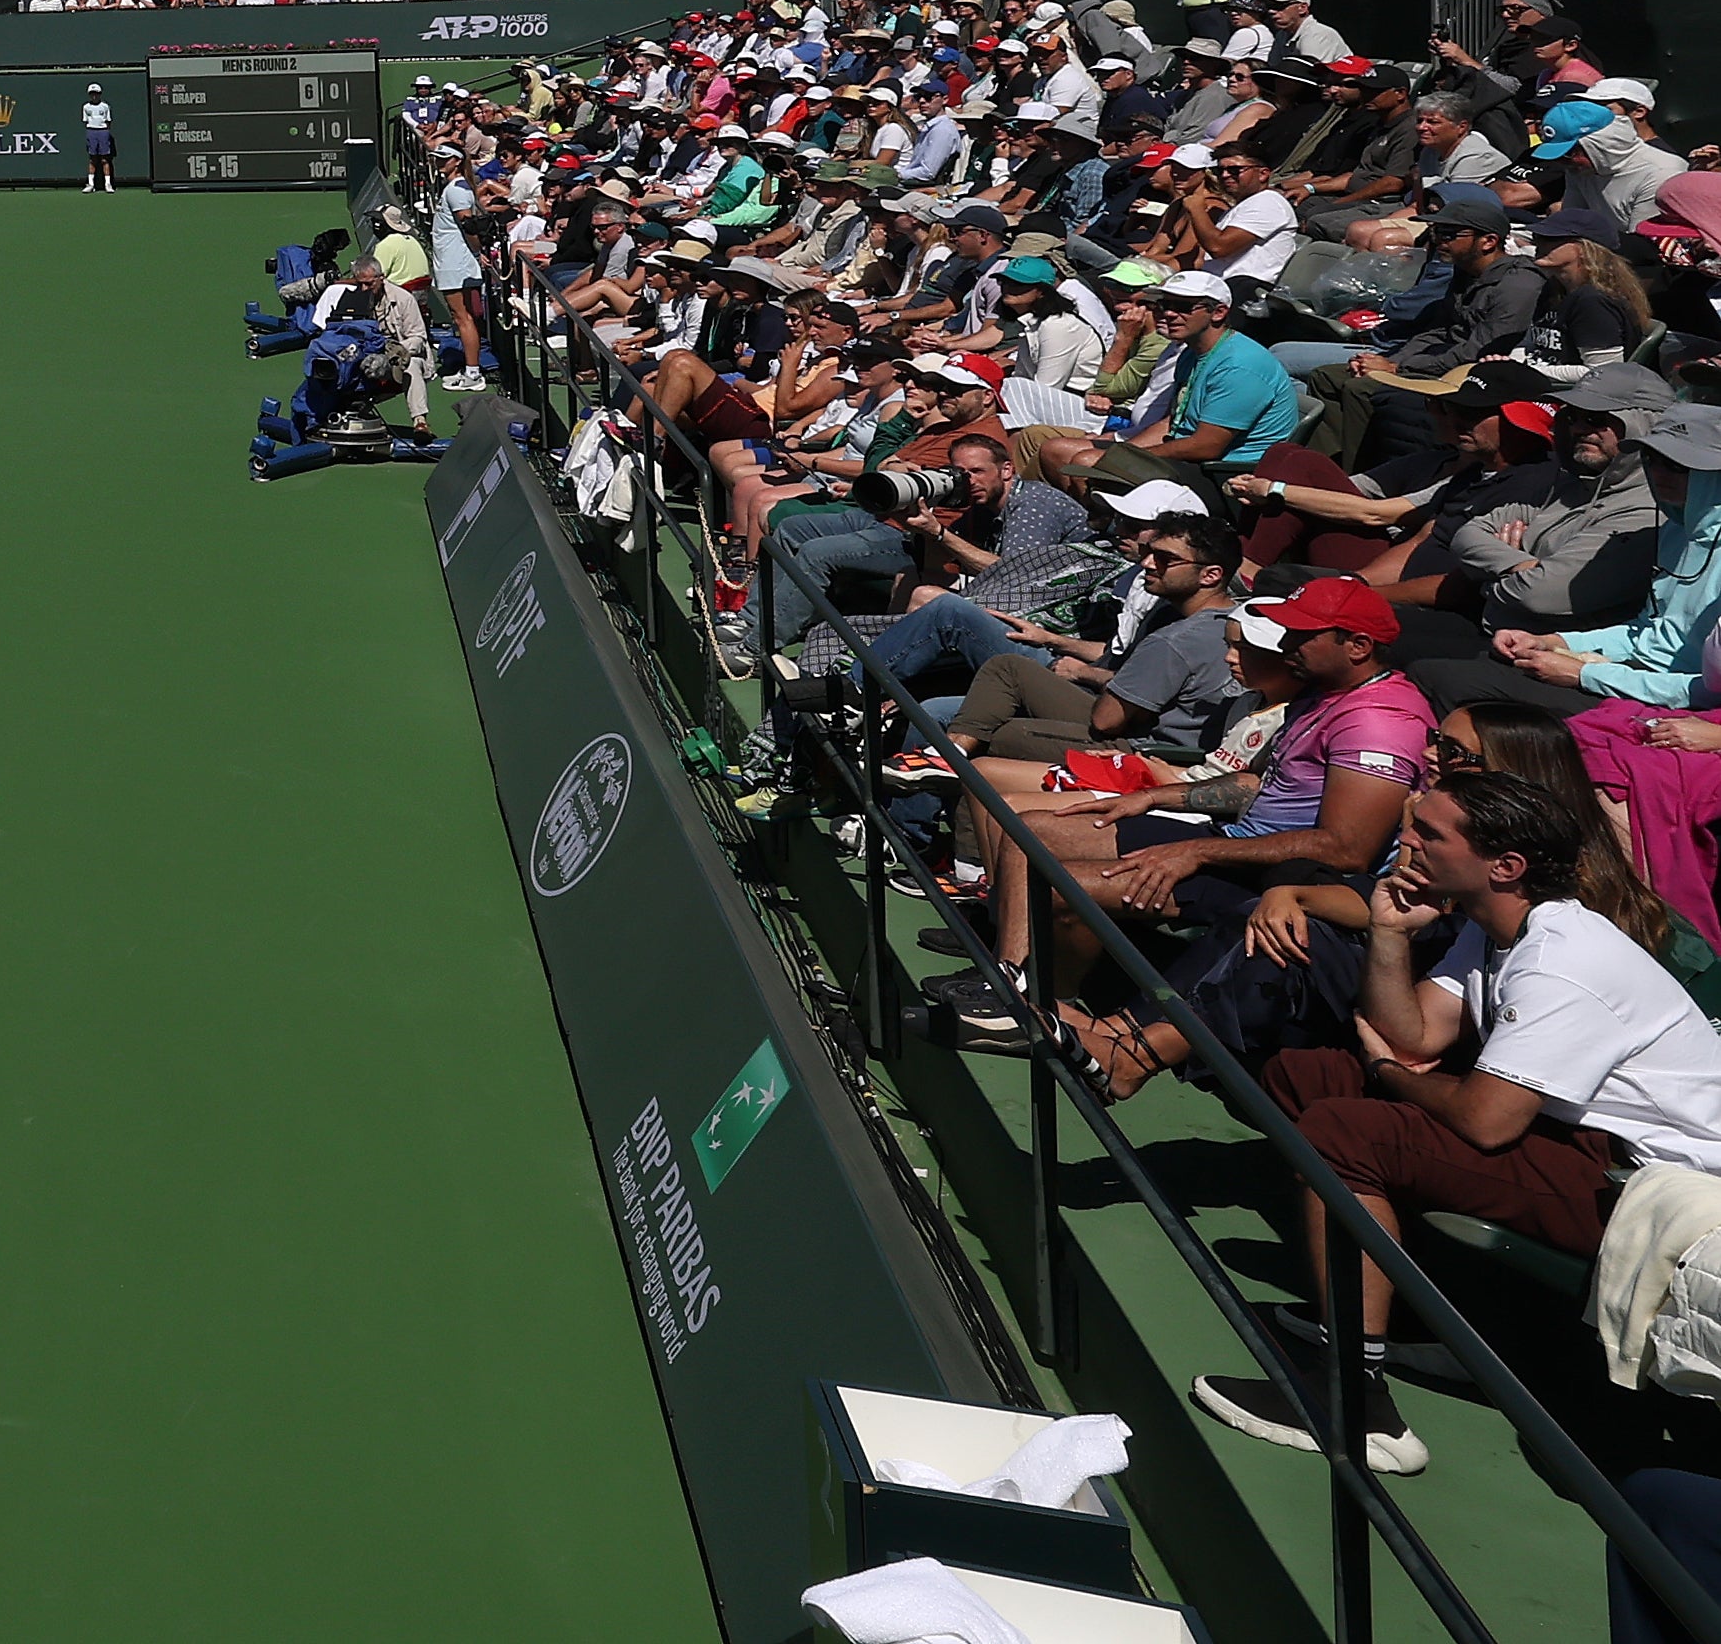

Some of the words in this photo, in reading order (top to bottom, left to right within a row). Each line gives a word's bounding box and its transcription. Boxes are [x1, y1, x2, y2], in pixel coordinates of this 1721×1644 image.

[417, 15, 497, 40] ATP
[500, 14, 547, 23] MASTERS
[500, 22, 549, 37] 1000
[222, 59, 252, 73] MEN'S
[254, 58, 288, 72] ROUND
[289, 57, 297, 71] 2
[172, 92, 207, 105] DRAPER
[305, 84, 313, 99] 6
[329, 83, 339, 99] 0
[174, 131, 213, 143] FONSECA
[305, 122, 315, 138] 4
[331, 121, 341, 139] 0
[543, 764, 602, 884] Veroni
[630, 1096, 671, 1174] BNP
[613, 1136, 629, 1174] The
[619, 1161, 642, 1209] bank
[624, 1196, 645, 1229] for
[635, 1224, 648, 1244] a
[650, 1161, 721, 1334] PARIBAS
[638, 1236, 669, 1318] changing
